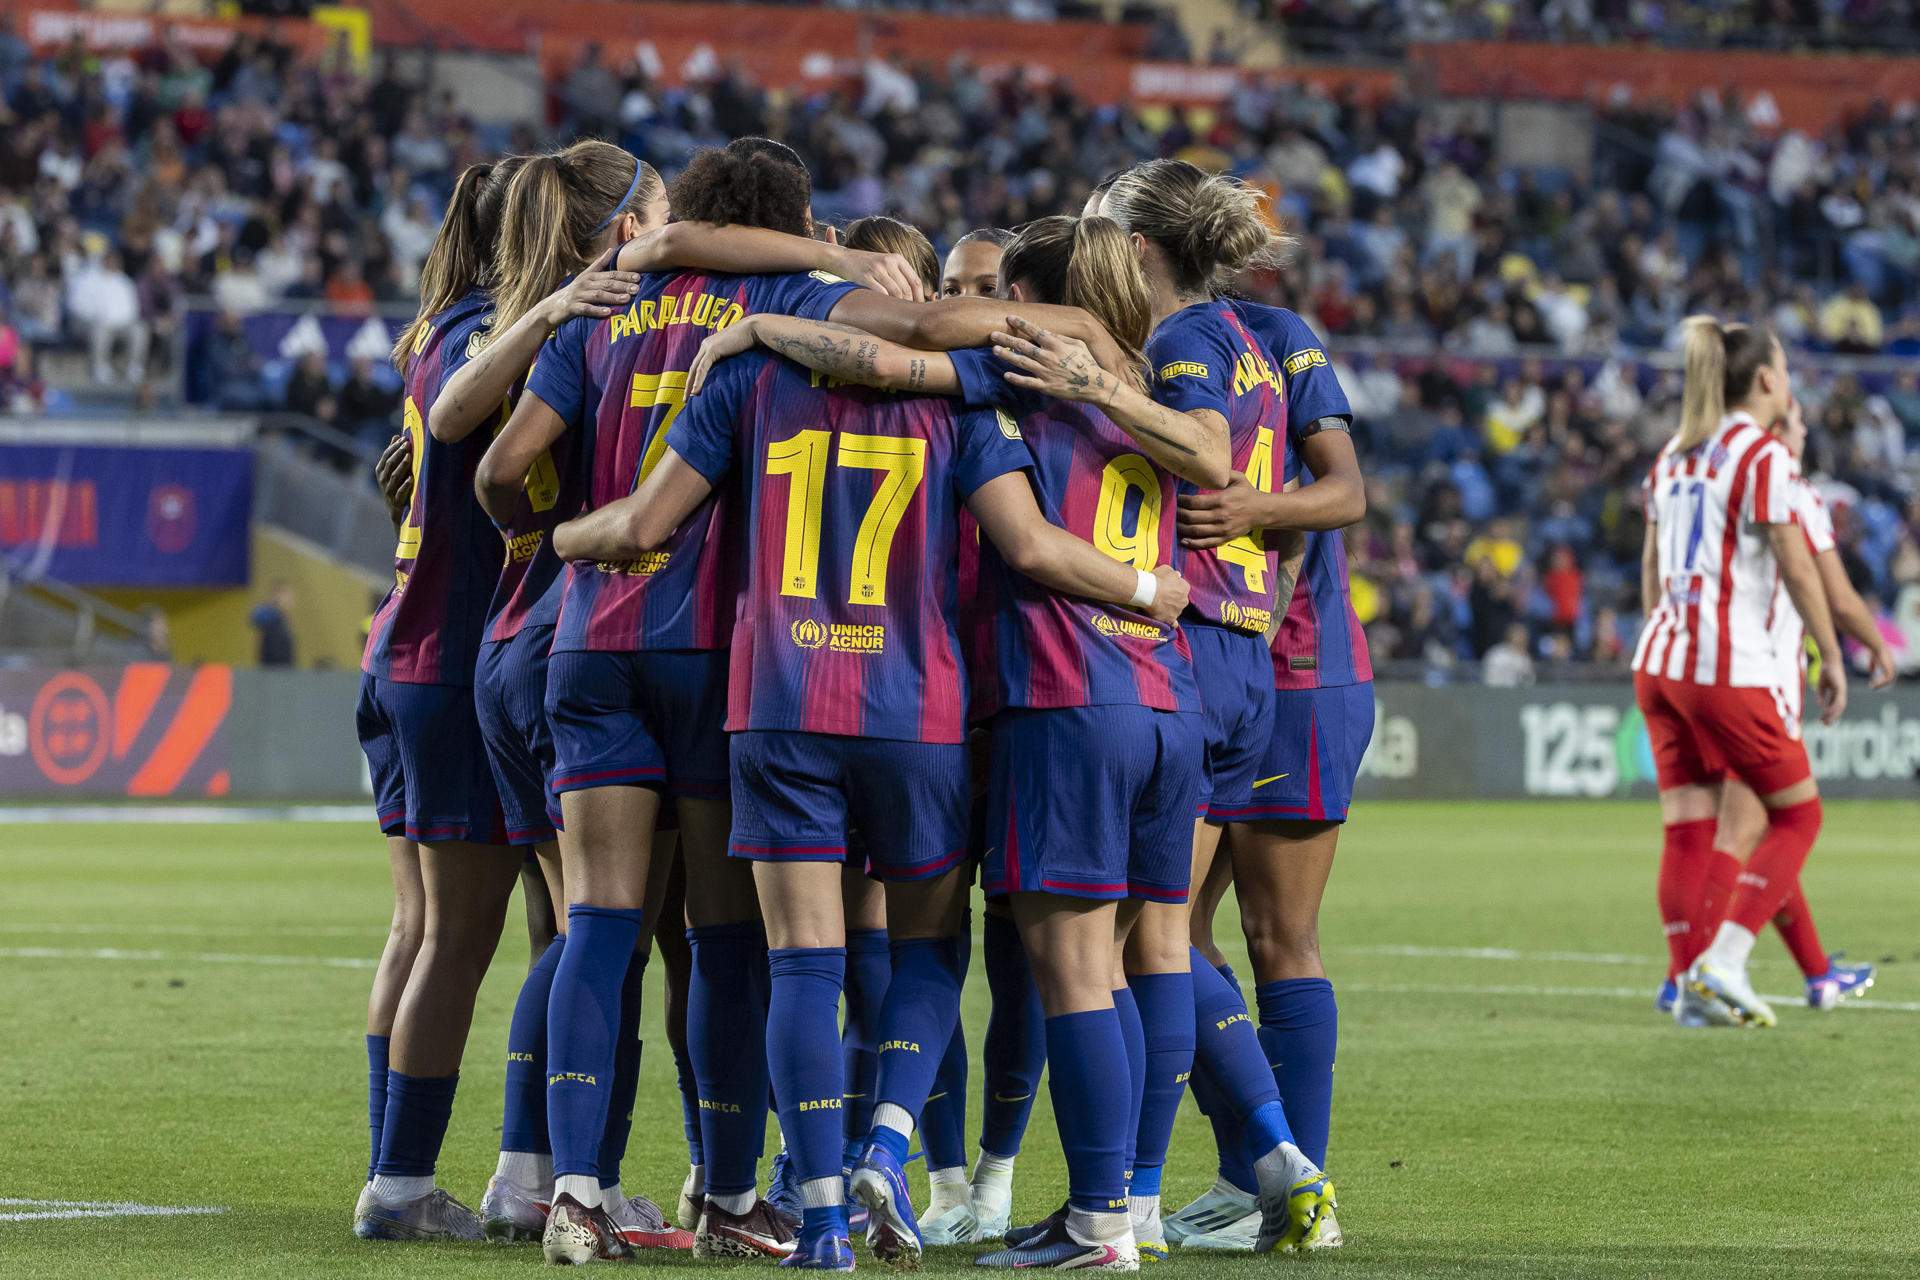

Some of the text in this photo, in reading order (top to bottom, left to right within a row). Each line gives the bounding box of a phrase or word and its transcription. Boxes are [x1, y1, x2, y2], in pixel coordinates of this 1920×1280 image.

[1161, 364, 1208, 379] BIMBO
[1286, 351, 1327, 375] BIMBO
[630, 371, 688, 487] 7
[766, 429, 928, 606] 17
[1093, 453, 1162, 573] 9
[1217, 425, 1274, 594] 4
[1242, 606, 1271, 624] UNHCR
[830, 623, 885, 637] UNHCR
[1120, 620, 1161, 638] UNHCR
[829, 636, 884, 649] ACNUR
[1522, 702, 1619, 796] 125
[878, 1040, 920, 1054] BARÇA
[549, 1072, 597, 1086] BARÇA
[800, 1098, 842, 1112] BARÇA
